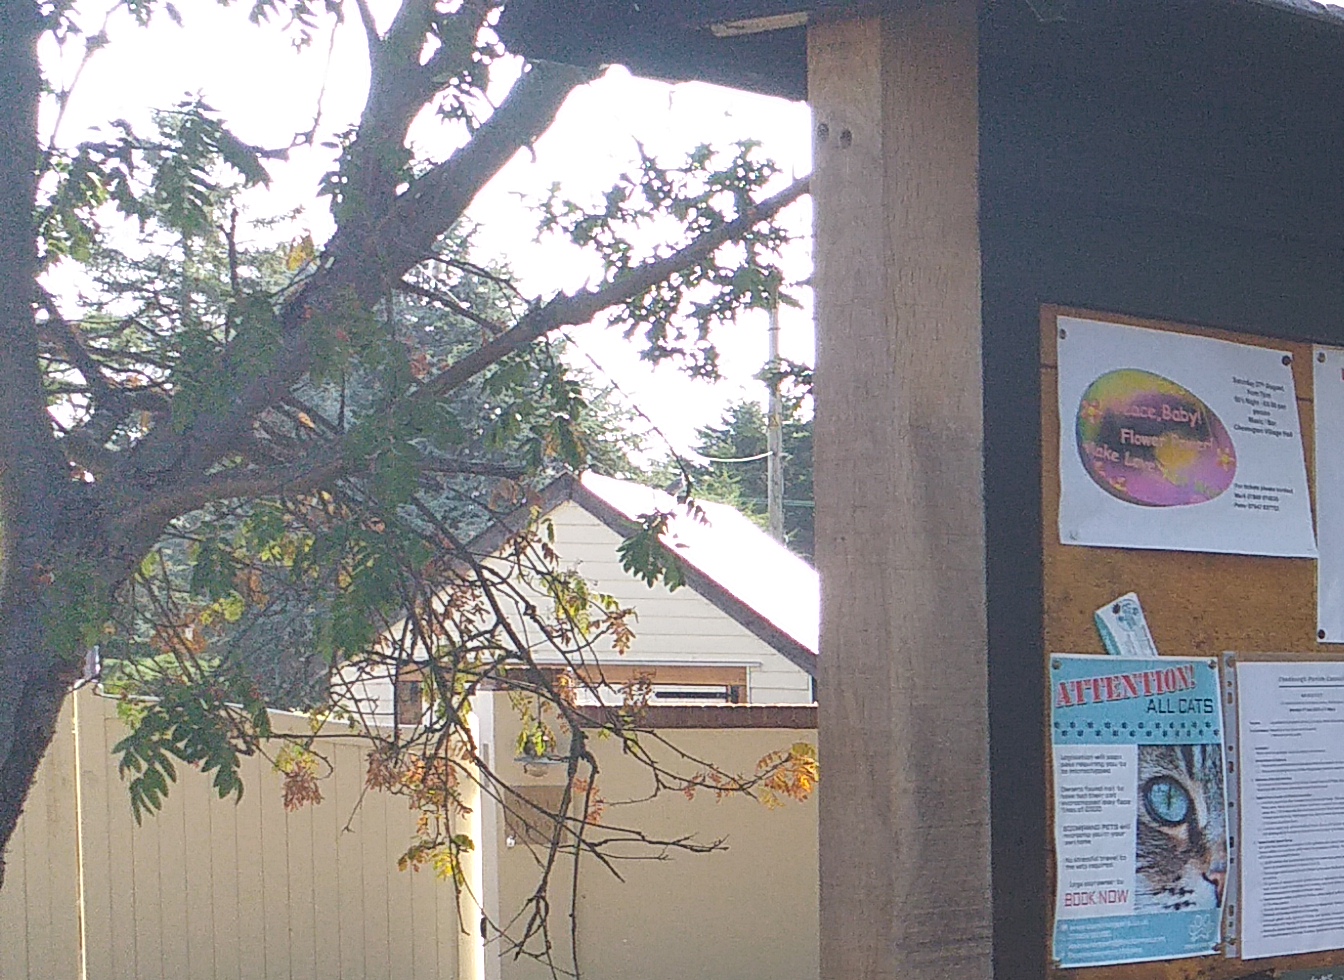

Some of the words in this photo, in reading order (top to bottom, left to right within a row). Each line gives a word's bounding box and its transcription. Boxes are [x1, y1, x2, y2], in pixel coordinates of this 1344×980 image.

[1120, 428, 1165, 447] Flower
[1054, 664, 1197, 708] ATTENTION!
[1146, 698, 1176, 714] ALL
[1178, 698, 1214, 714] CATS
[1065, 891, 1097, 907] BOOK
[1098, 889, 1129, 904] NOW
